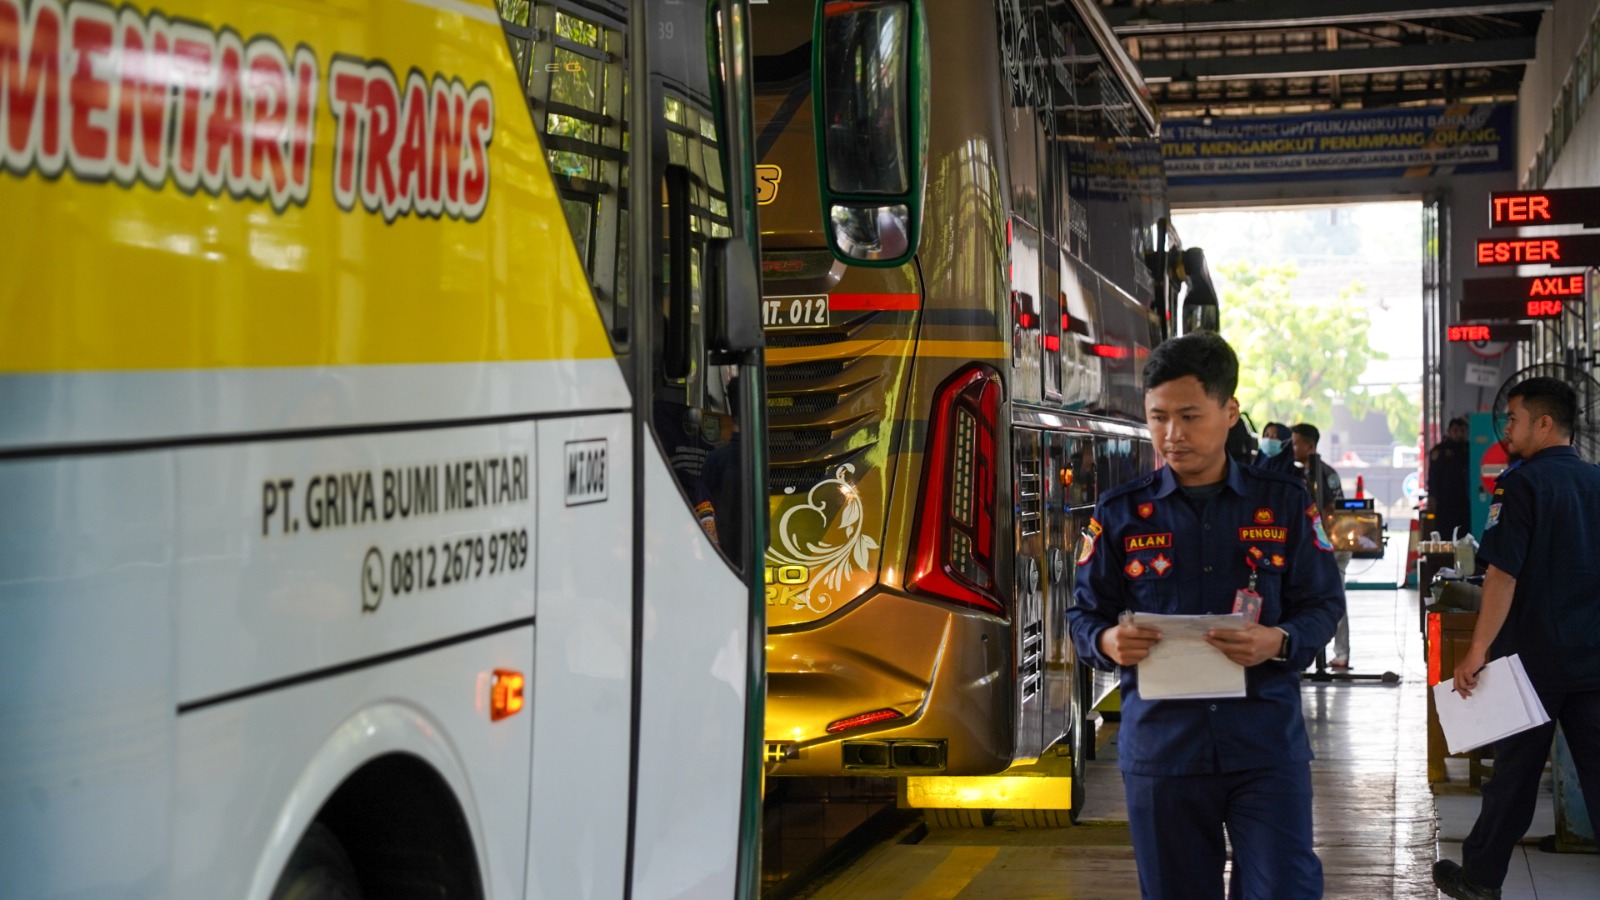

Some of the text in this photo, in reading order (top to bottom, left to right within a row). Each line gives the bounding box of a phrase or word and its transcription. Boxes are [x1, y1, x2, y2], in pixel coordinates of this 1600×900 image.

[0, 0, 494, 222] MENTARI TRANS
[1200, 137, 1316, 155] MENGANGKUT
[1320, 131, 1424, 150] PENUMPANG
[1494, 196, 1550, 221] TER
[1478, 240, 1560, 263] ESTER
[1530, 276, 1584, 296] AXLE
[790, 299, 826, 324] 012
[262, 455, 528, 536] PT. GRIYA BUMI MENTARI
[1130, 536, 1165, 549] ALAN
[1242, 529, 1285, 540] PENGUJI
[390, 529, 528, 596] 0812 2679 9789
